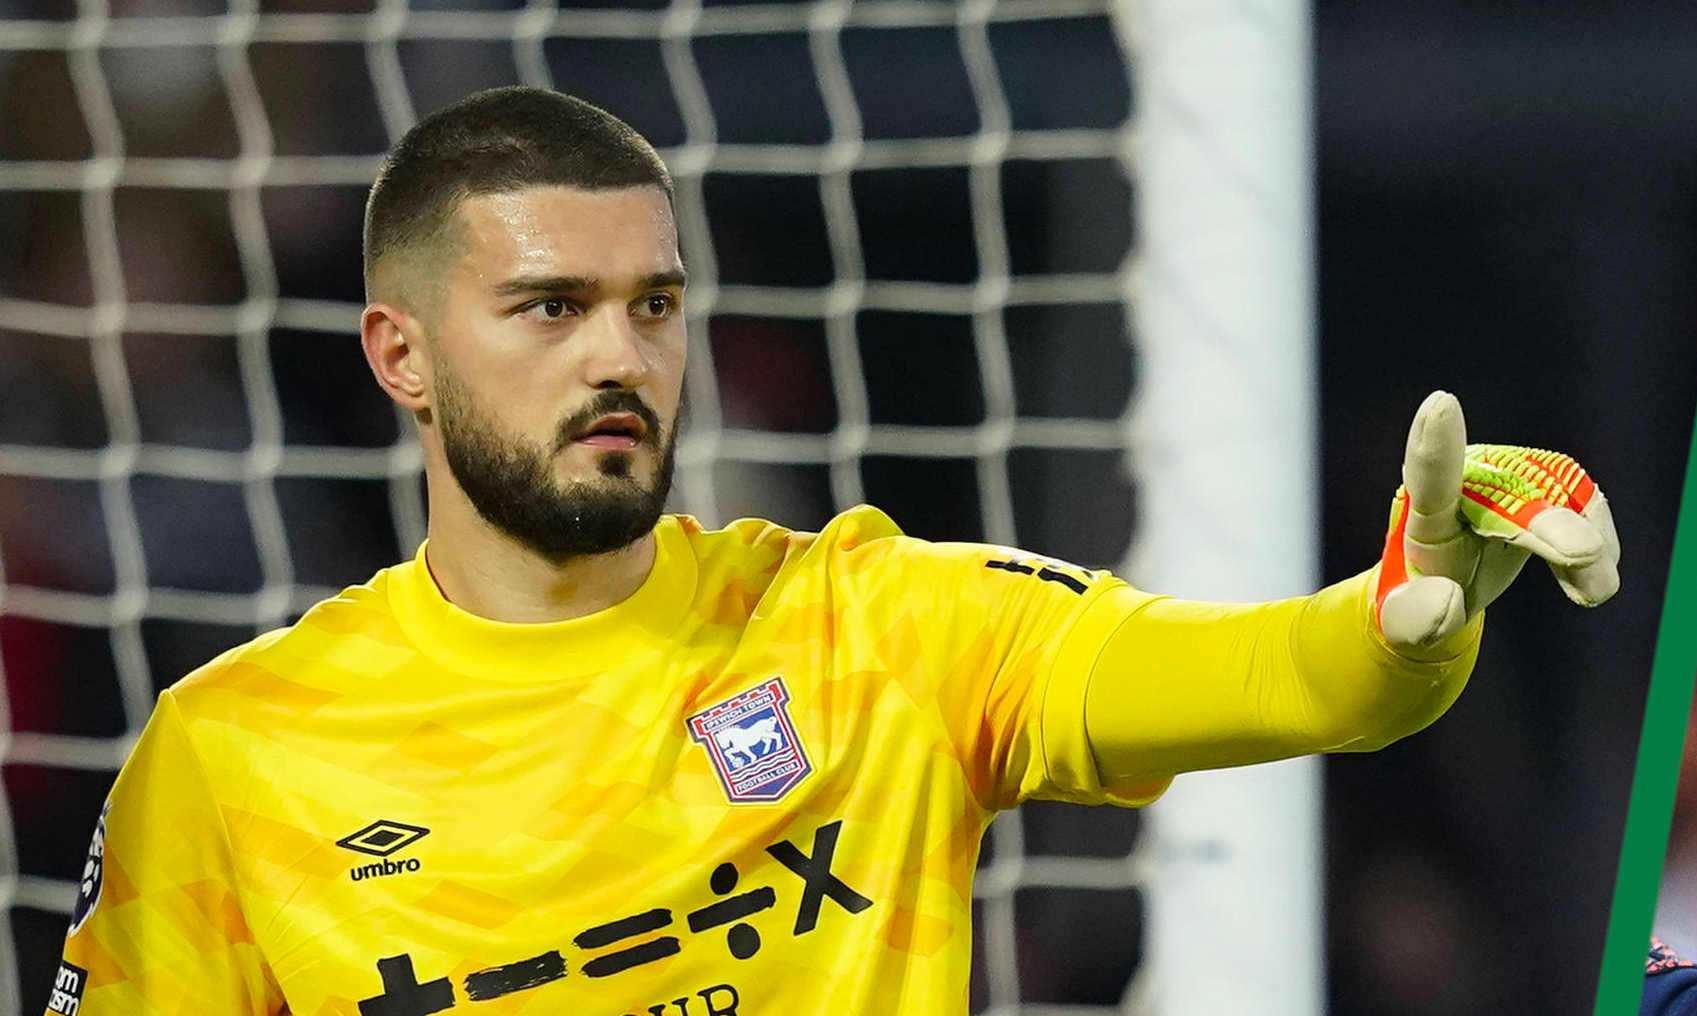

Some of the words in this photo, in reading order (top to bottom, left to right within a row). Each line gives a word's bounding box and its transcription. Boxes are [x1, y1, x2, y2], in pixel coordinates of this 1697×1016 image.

[706, 707, 744, 729] IPSWICH
[745, 694, 772, 711] TOWN
[738, 770, 776, 791] FOOTBALL
[776, 762, 796, 775] CLUB
[351, 858, 420, 881] umbro
